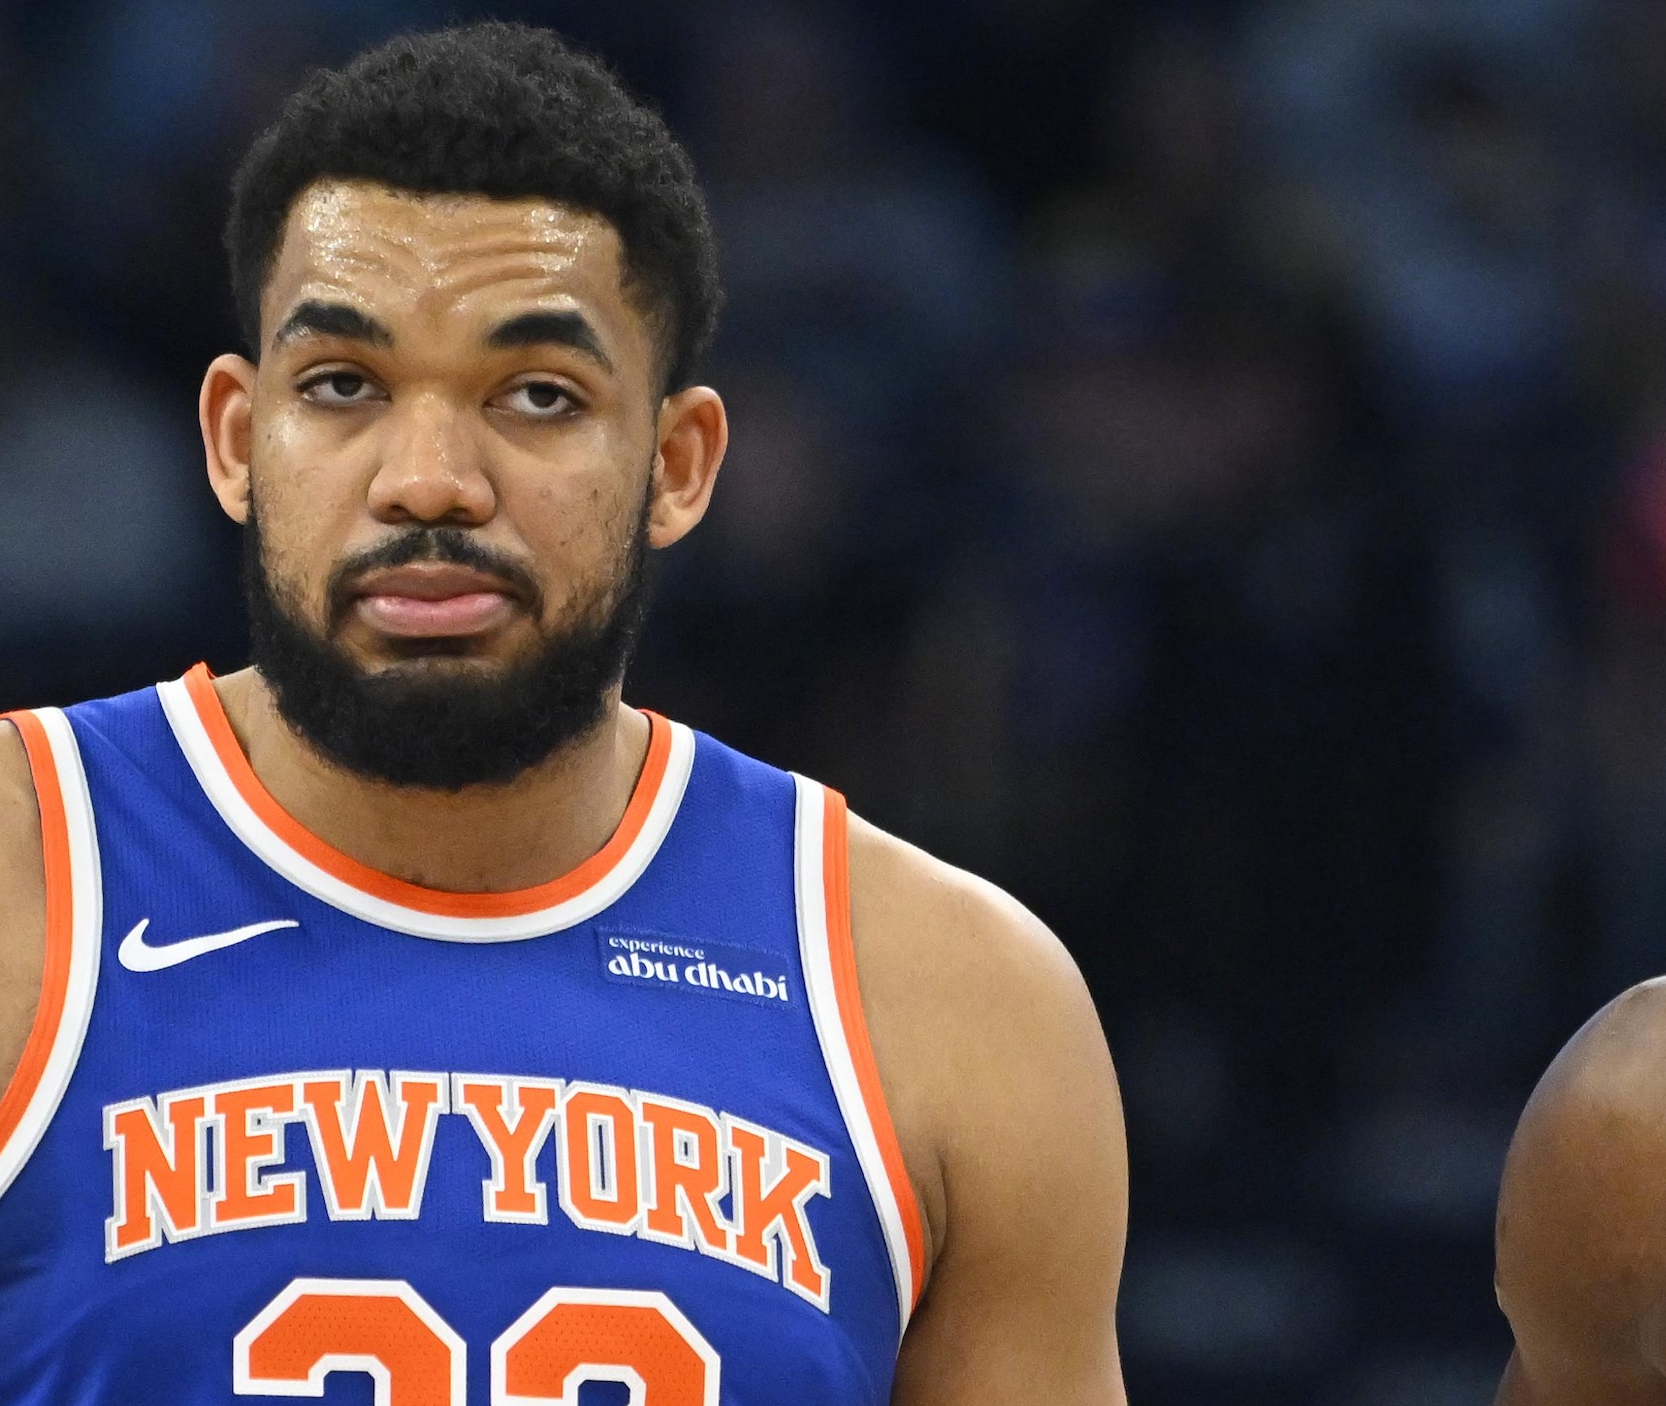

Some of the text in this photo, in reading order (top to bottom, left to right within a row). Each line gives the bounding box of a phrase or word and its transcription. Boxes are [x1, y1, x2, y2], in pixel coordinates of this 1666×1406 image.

[608, 936, 705, 960] experience
[608, 952, 789, 1002] abu dhabi
[104, 1069, 831, 1314] NEW YORK
